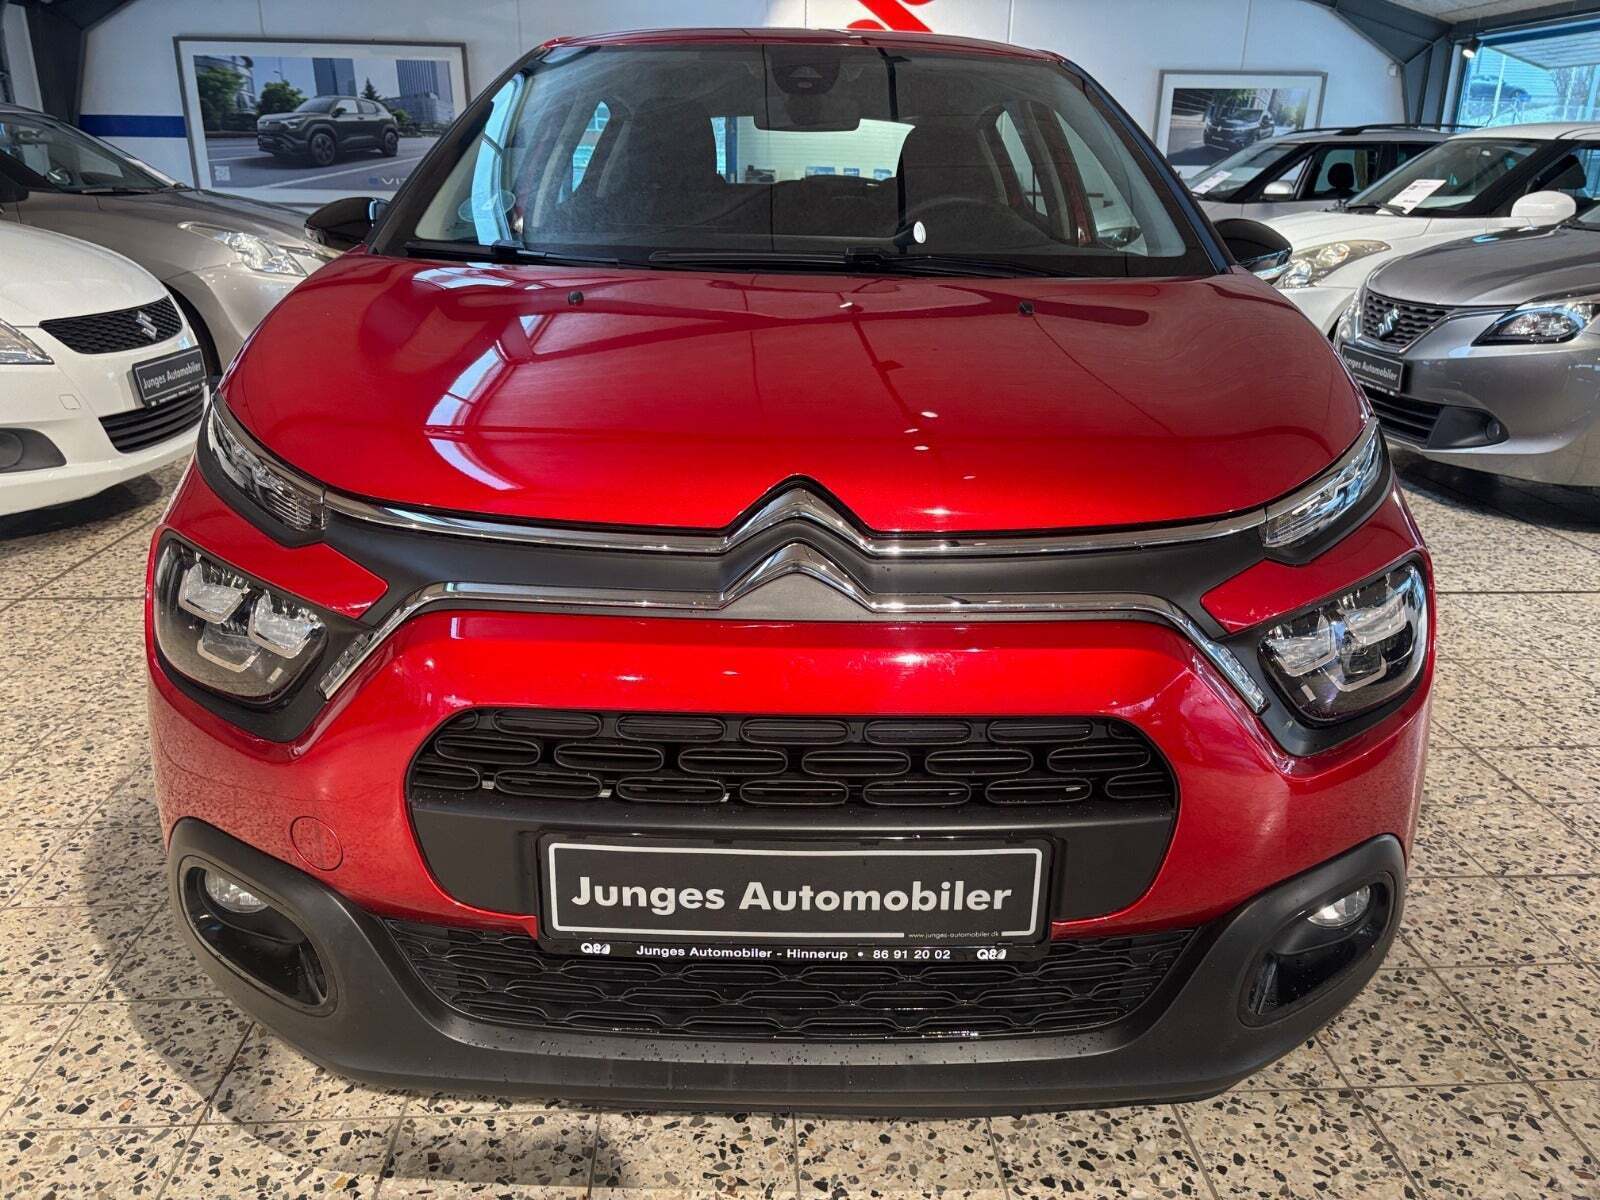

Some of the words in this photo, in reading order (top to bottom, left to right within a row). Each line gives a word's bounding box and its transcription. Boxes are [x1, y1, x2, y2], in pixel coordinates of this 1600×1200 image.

[143, 374, 167, 390] Junges
[166, 361, 201, 382] Automobiler
[1362, 361, 1399, 381] Automobiler
[571, 876, 726, 916] Junges
[738, 880, 1013, 912] Automobiler
[908, 930, 999, 940] www.junges-automobiler.dk
[636, 945, 686, 958] Junges
[689, 946, 773, 959] Automobiler
[786, 948, 848, 961] Hinnerup
[872, 949, 889, 960] 86
[893, 949, 908, 960] 91
[914, 949, 931, 960] 20
[934, 949, 951, 960] 02
